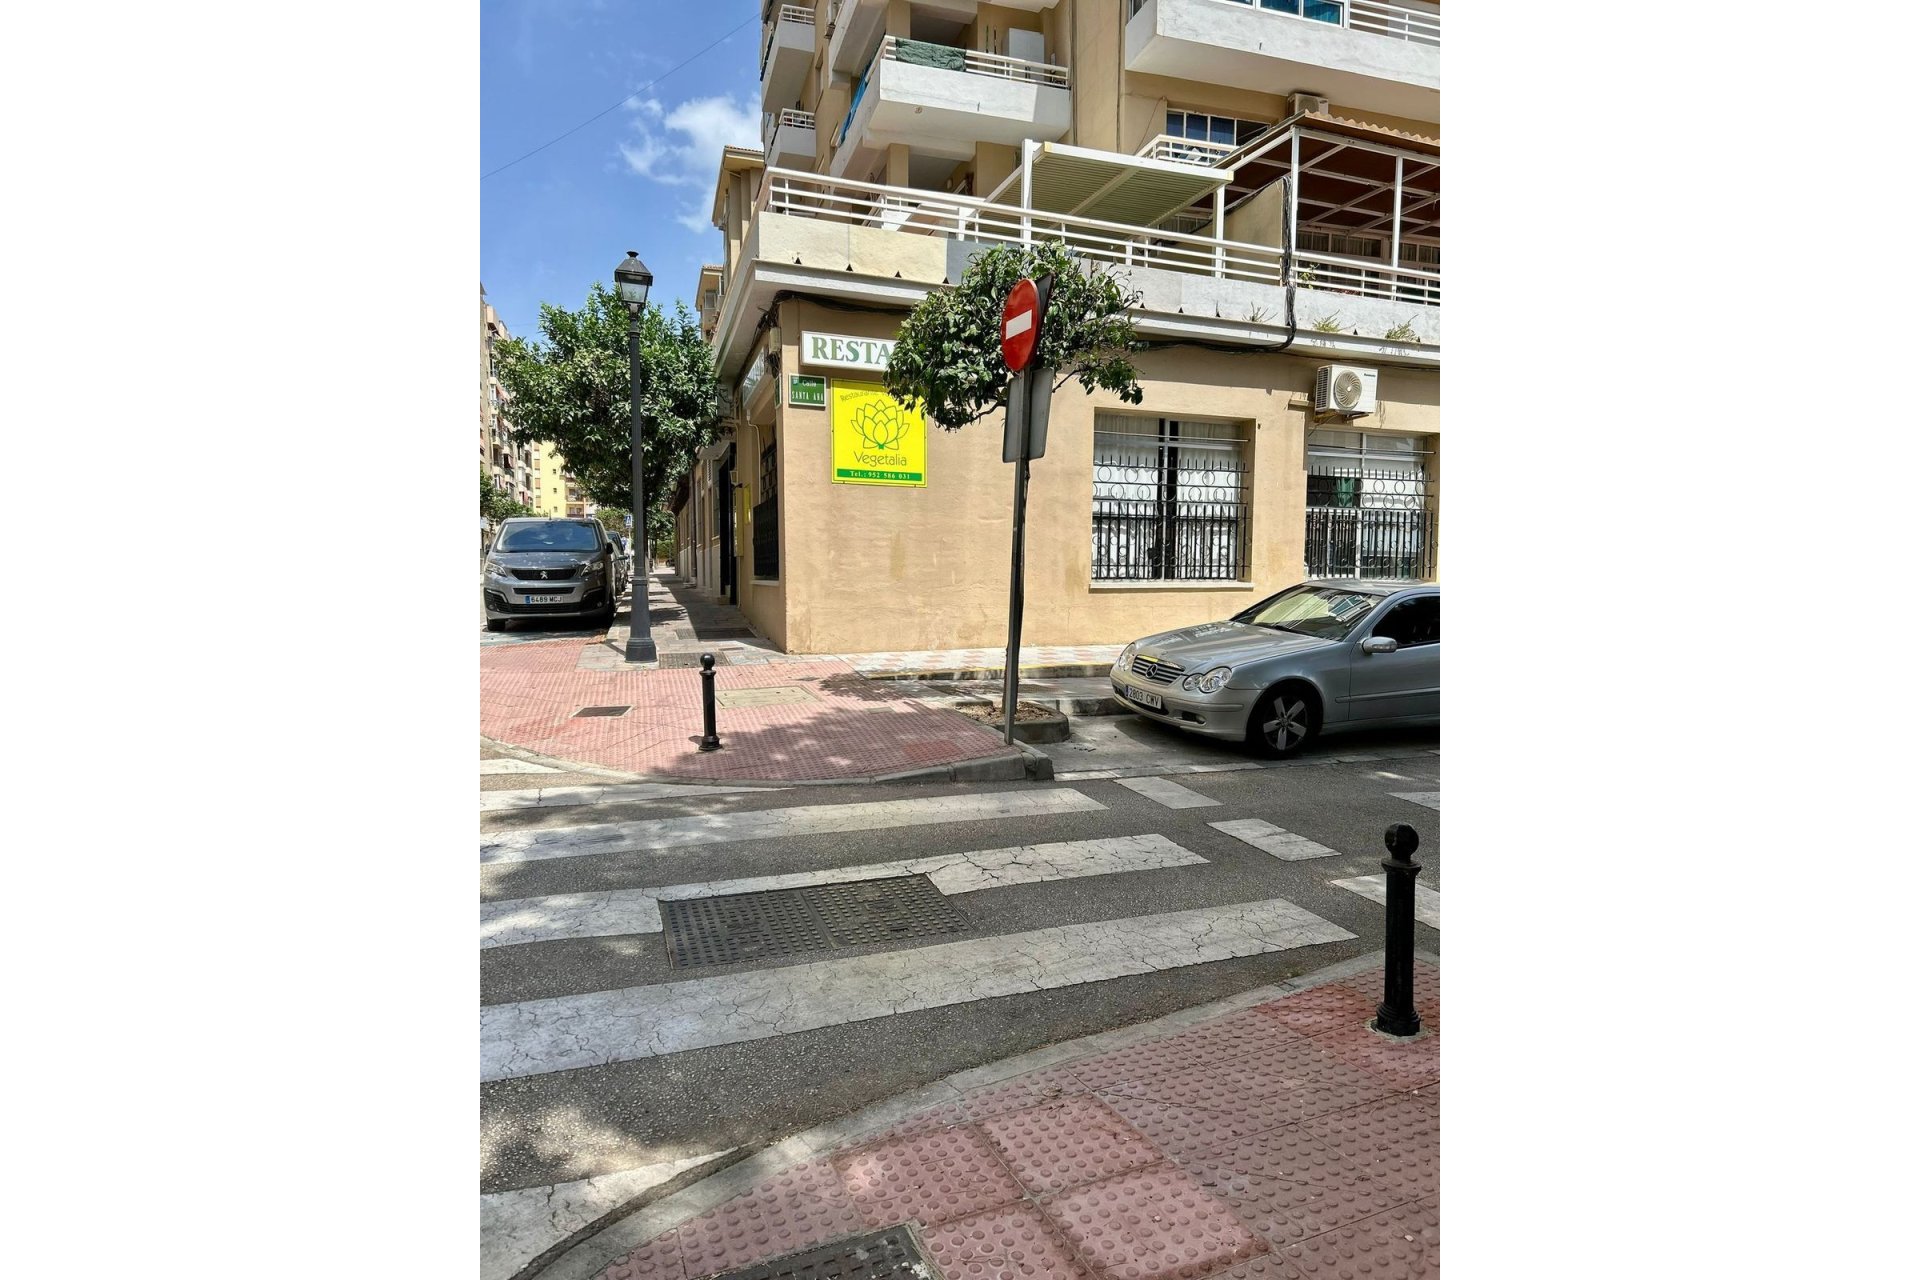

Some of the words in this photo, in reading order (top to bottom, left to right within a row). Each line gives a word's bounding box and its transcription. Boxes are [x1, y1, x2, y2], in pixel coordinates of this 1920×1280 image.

[811, 336, 893, 364] RESTA
[853, 451, 907, 467] Vegetalia
[868, 471, 880, 479] 952
[883, 472, 896, 480] 586
[1129, 688, 1143, 701] 2803
